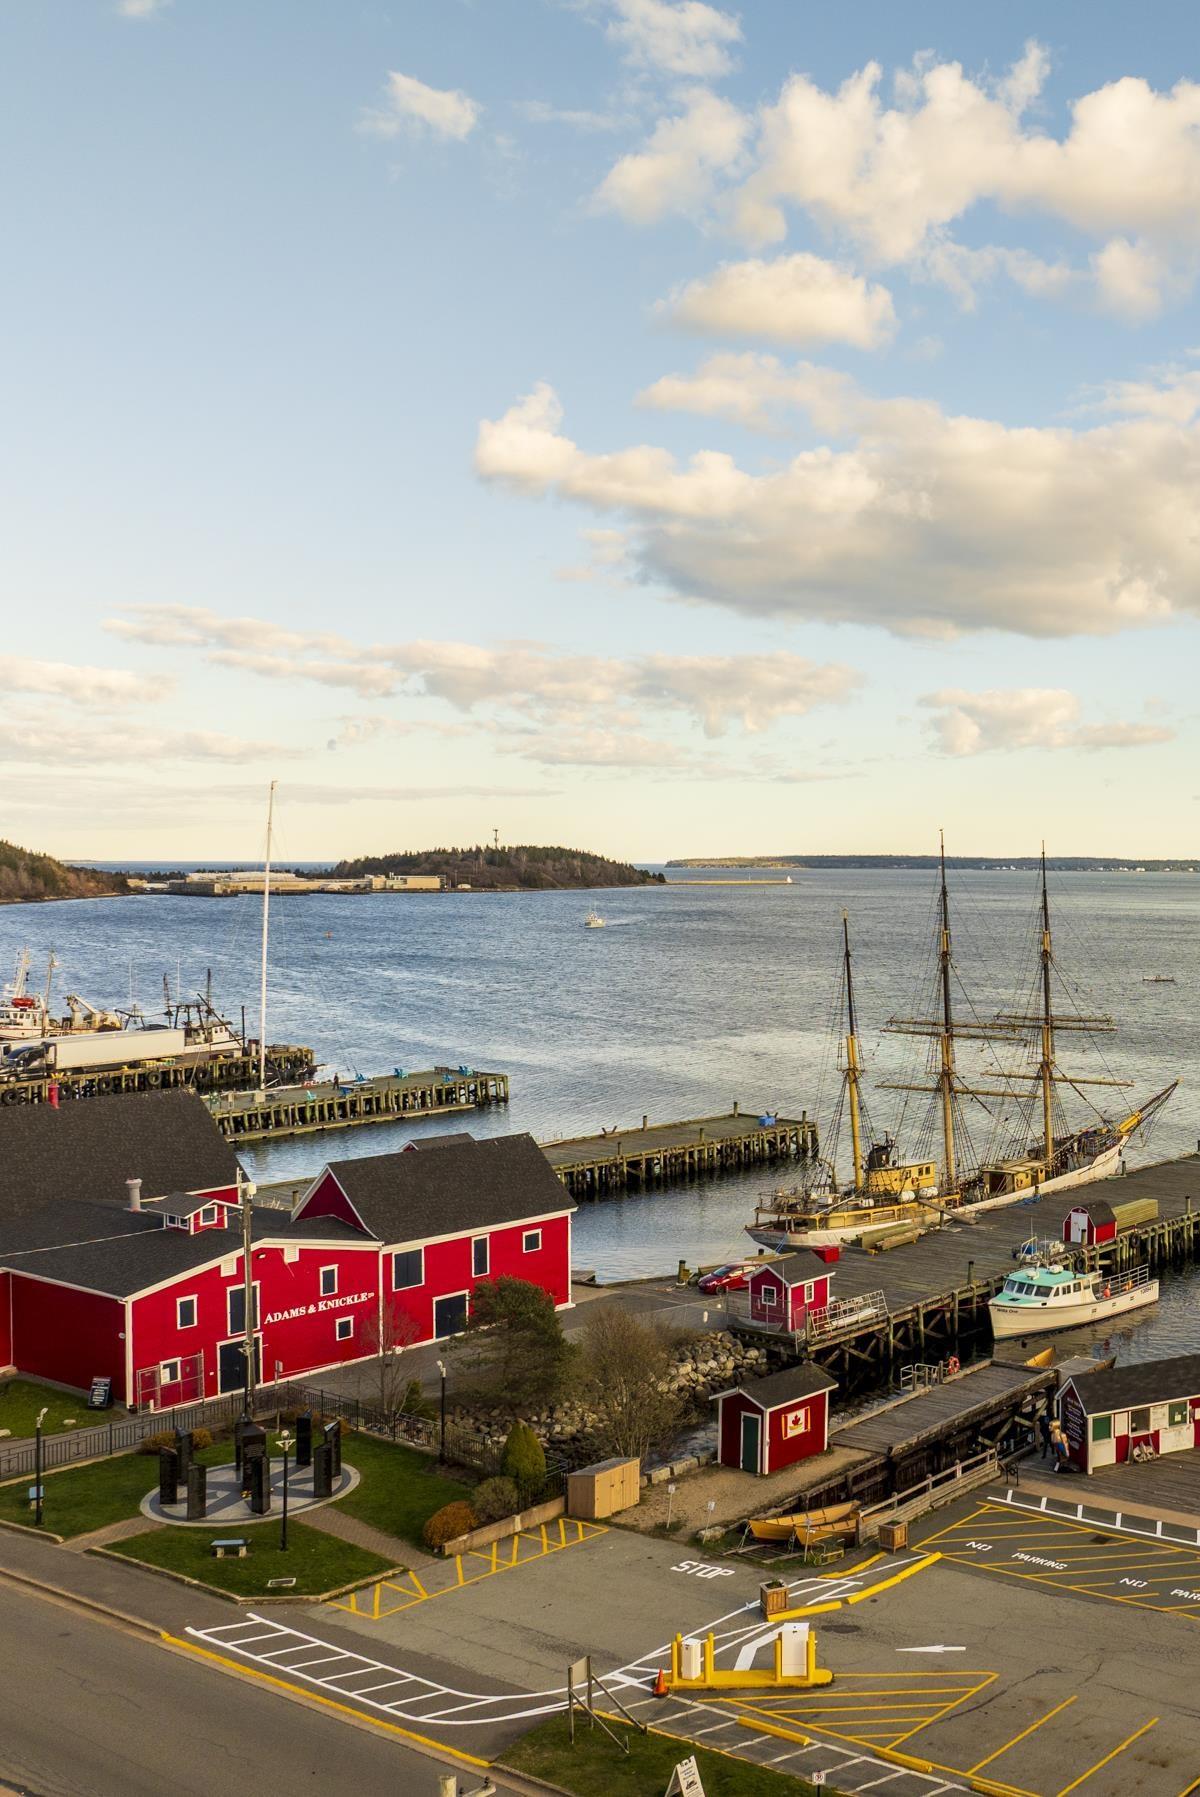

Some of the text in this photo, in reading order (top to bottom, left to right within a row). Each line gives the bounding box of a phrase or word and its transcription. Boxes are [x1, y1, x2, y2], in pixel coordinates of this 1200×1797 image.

[264, 1292, 368, 1325] ADAMS & KNICKLE
[965, 1541, 993, 1551] NO
[670, 1560, 736, 1579] STOP
[1119, 1577, 1149, 1588] NO
